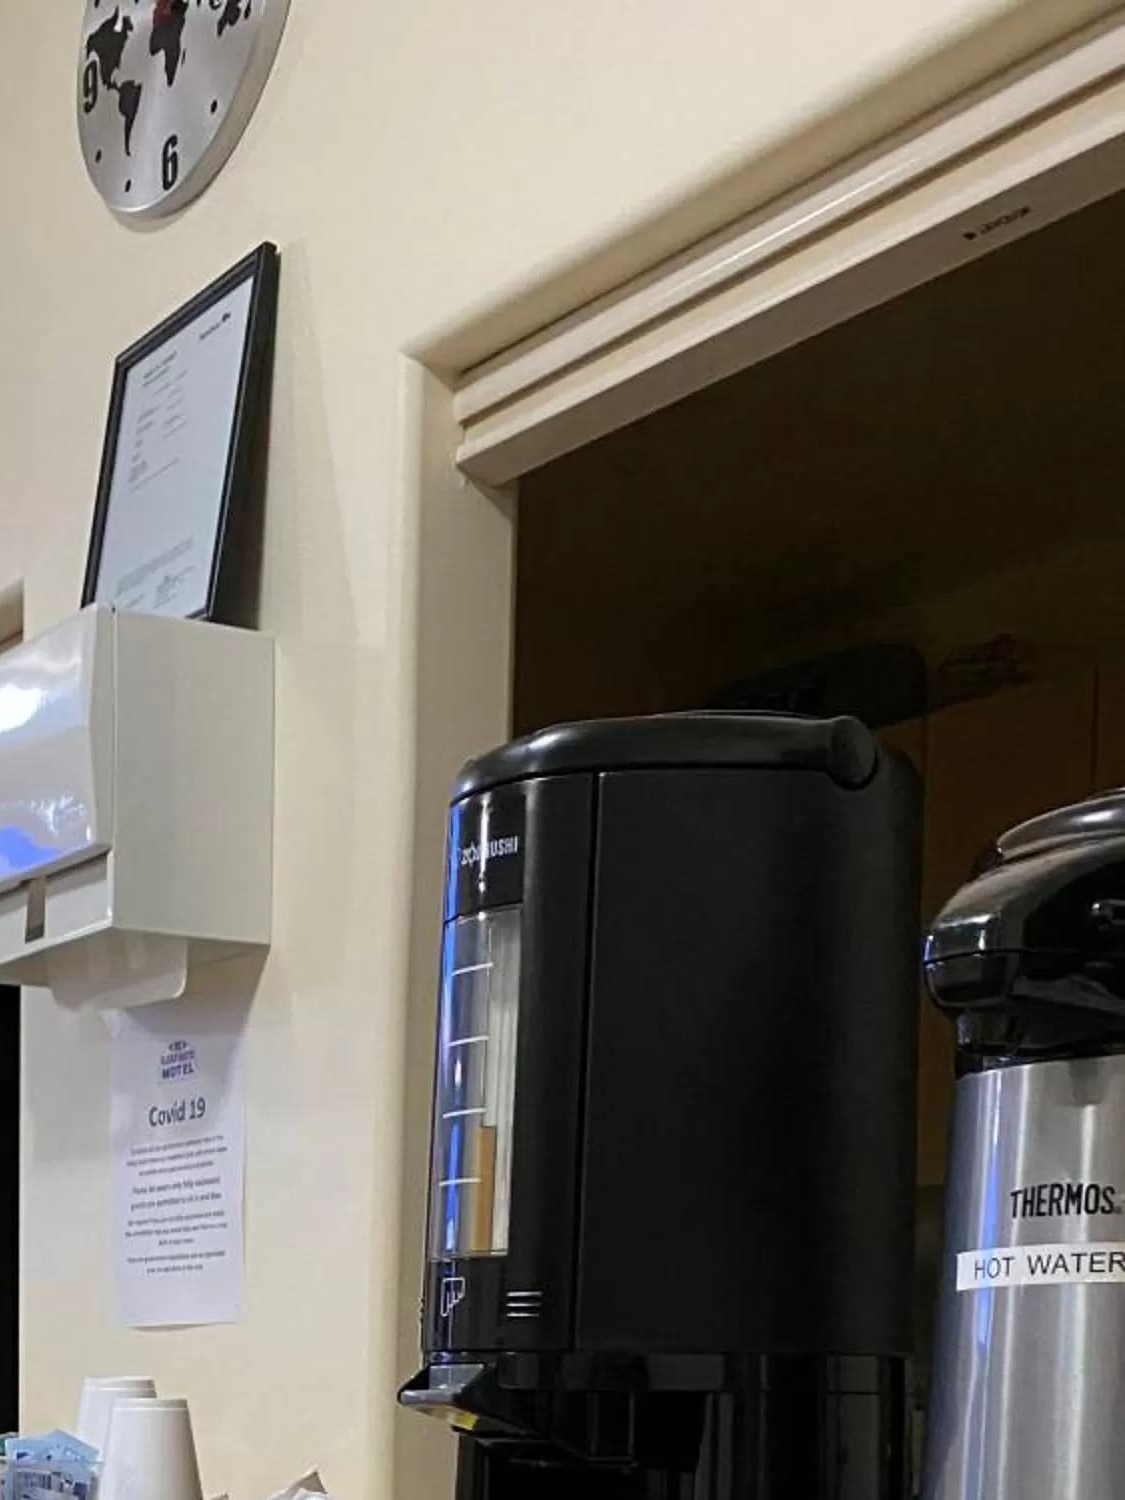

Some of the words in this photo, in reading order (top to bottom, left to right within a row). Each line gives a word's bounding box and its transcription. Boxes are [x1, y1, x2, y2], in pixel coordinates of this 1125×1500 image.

[83, 60, 98, 115] 9
[162, 133, 178, 191] 6
[148, 1099, 186, 1127] Covid
[189, 1096, 206, 1120] 19
[1010, 1183, 1116, 1218] THERMOS
[975, 1257, 1016, 1281] HOT
[1027, 1251, 1125, 1276] WATER
